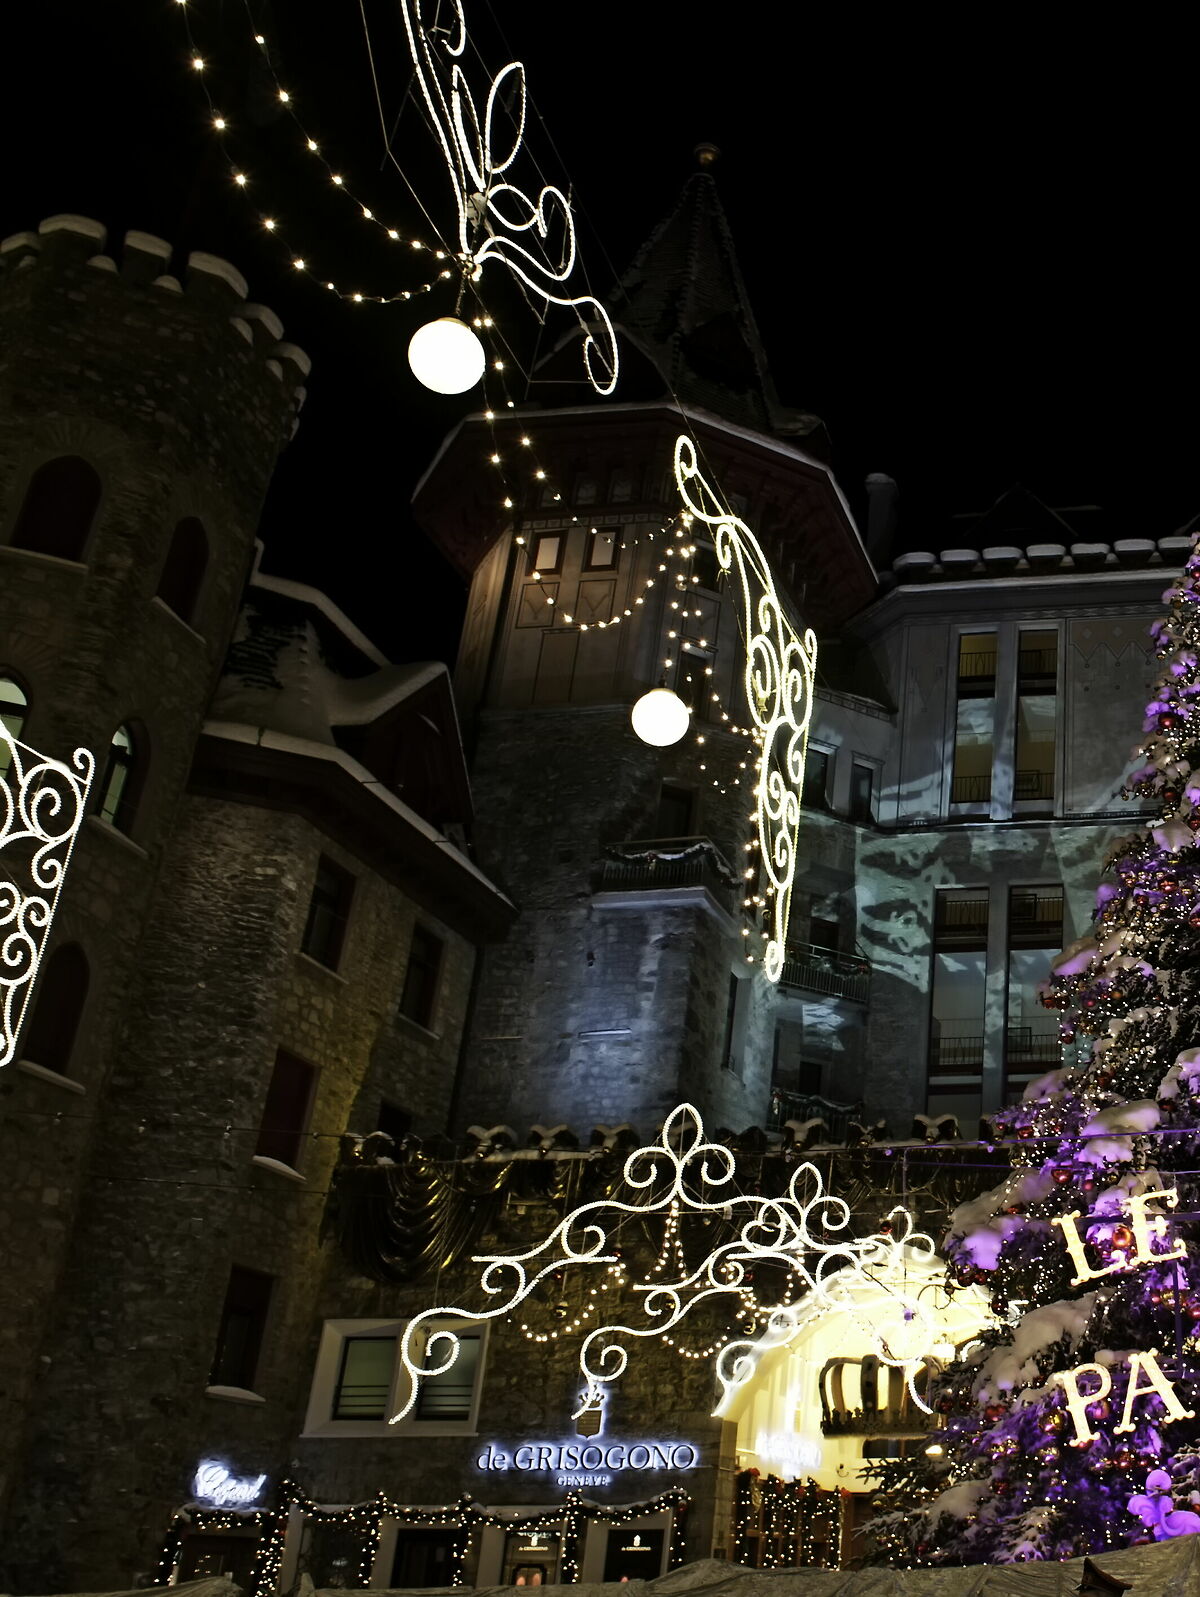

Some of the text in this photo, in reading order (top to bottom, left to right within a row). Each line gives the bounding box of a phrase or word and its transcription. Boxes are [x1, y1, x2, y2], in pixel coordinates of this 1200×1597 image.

[1051, 1188, 1186, 1287] LE
[477, 1444, 696, 1470] de GRISOGONO
